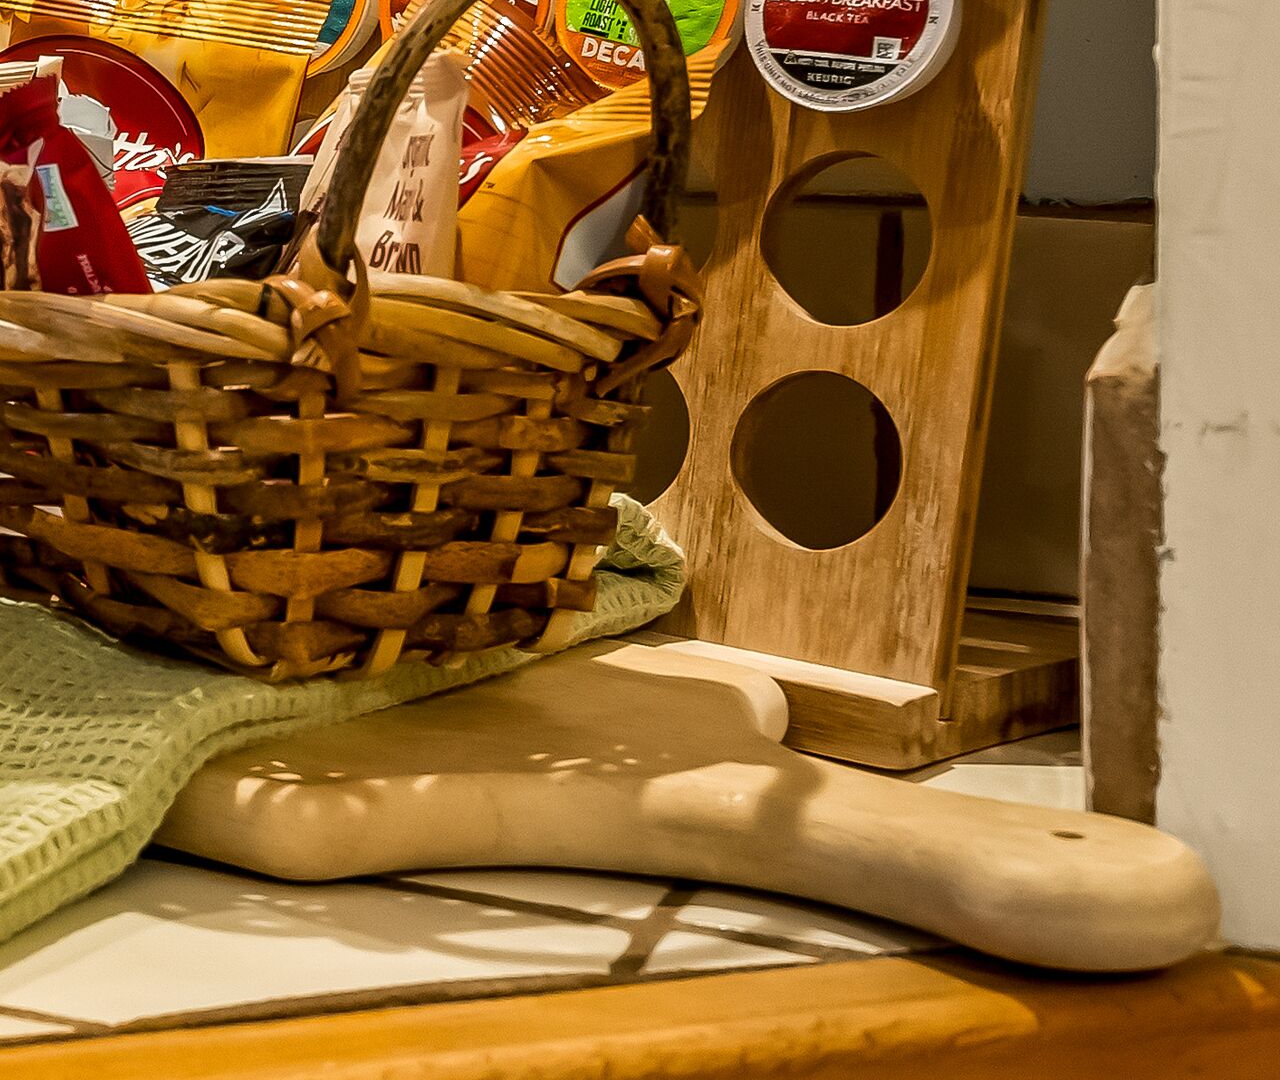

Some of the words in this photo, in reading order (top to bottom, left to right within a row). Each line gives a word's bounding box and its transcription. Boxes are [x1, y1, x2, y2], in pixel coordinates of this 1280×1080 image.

[582, 11, 616, 32] ROAST
[806, 11, 844, 23] BLACK
[846, 13, 870, 24] TEA
[581, 36, 646, 72] DECA
[807, 72, 856, 85] KEURIG
